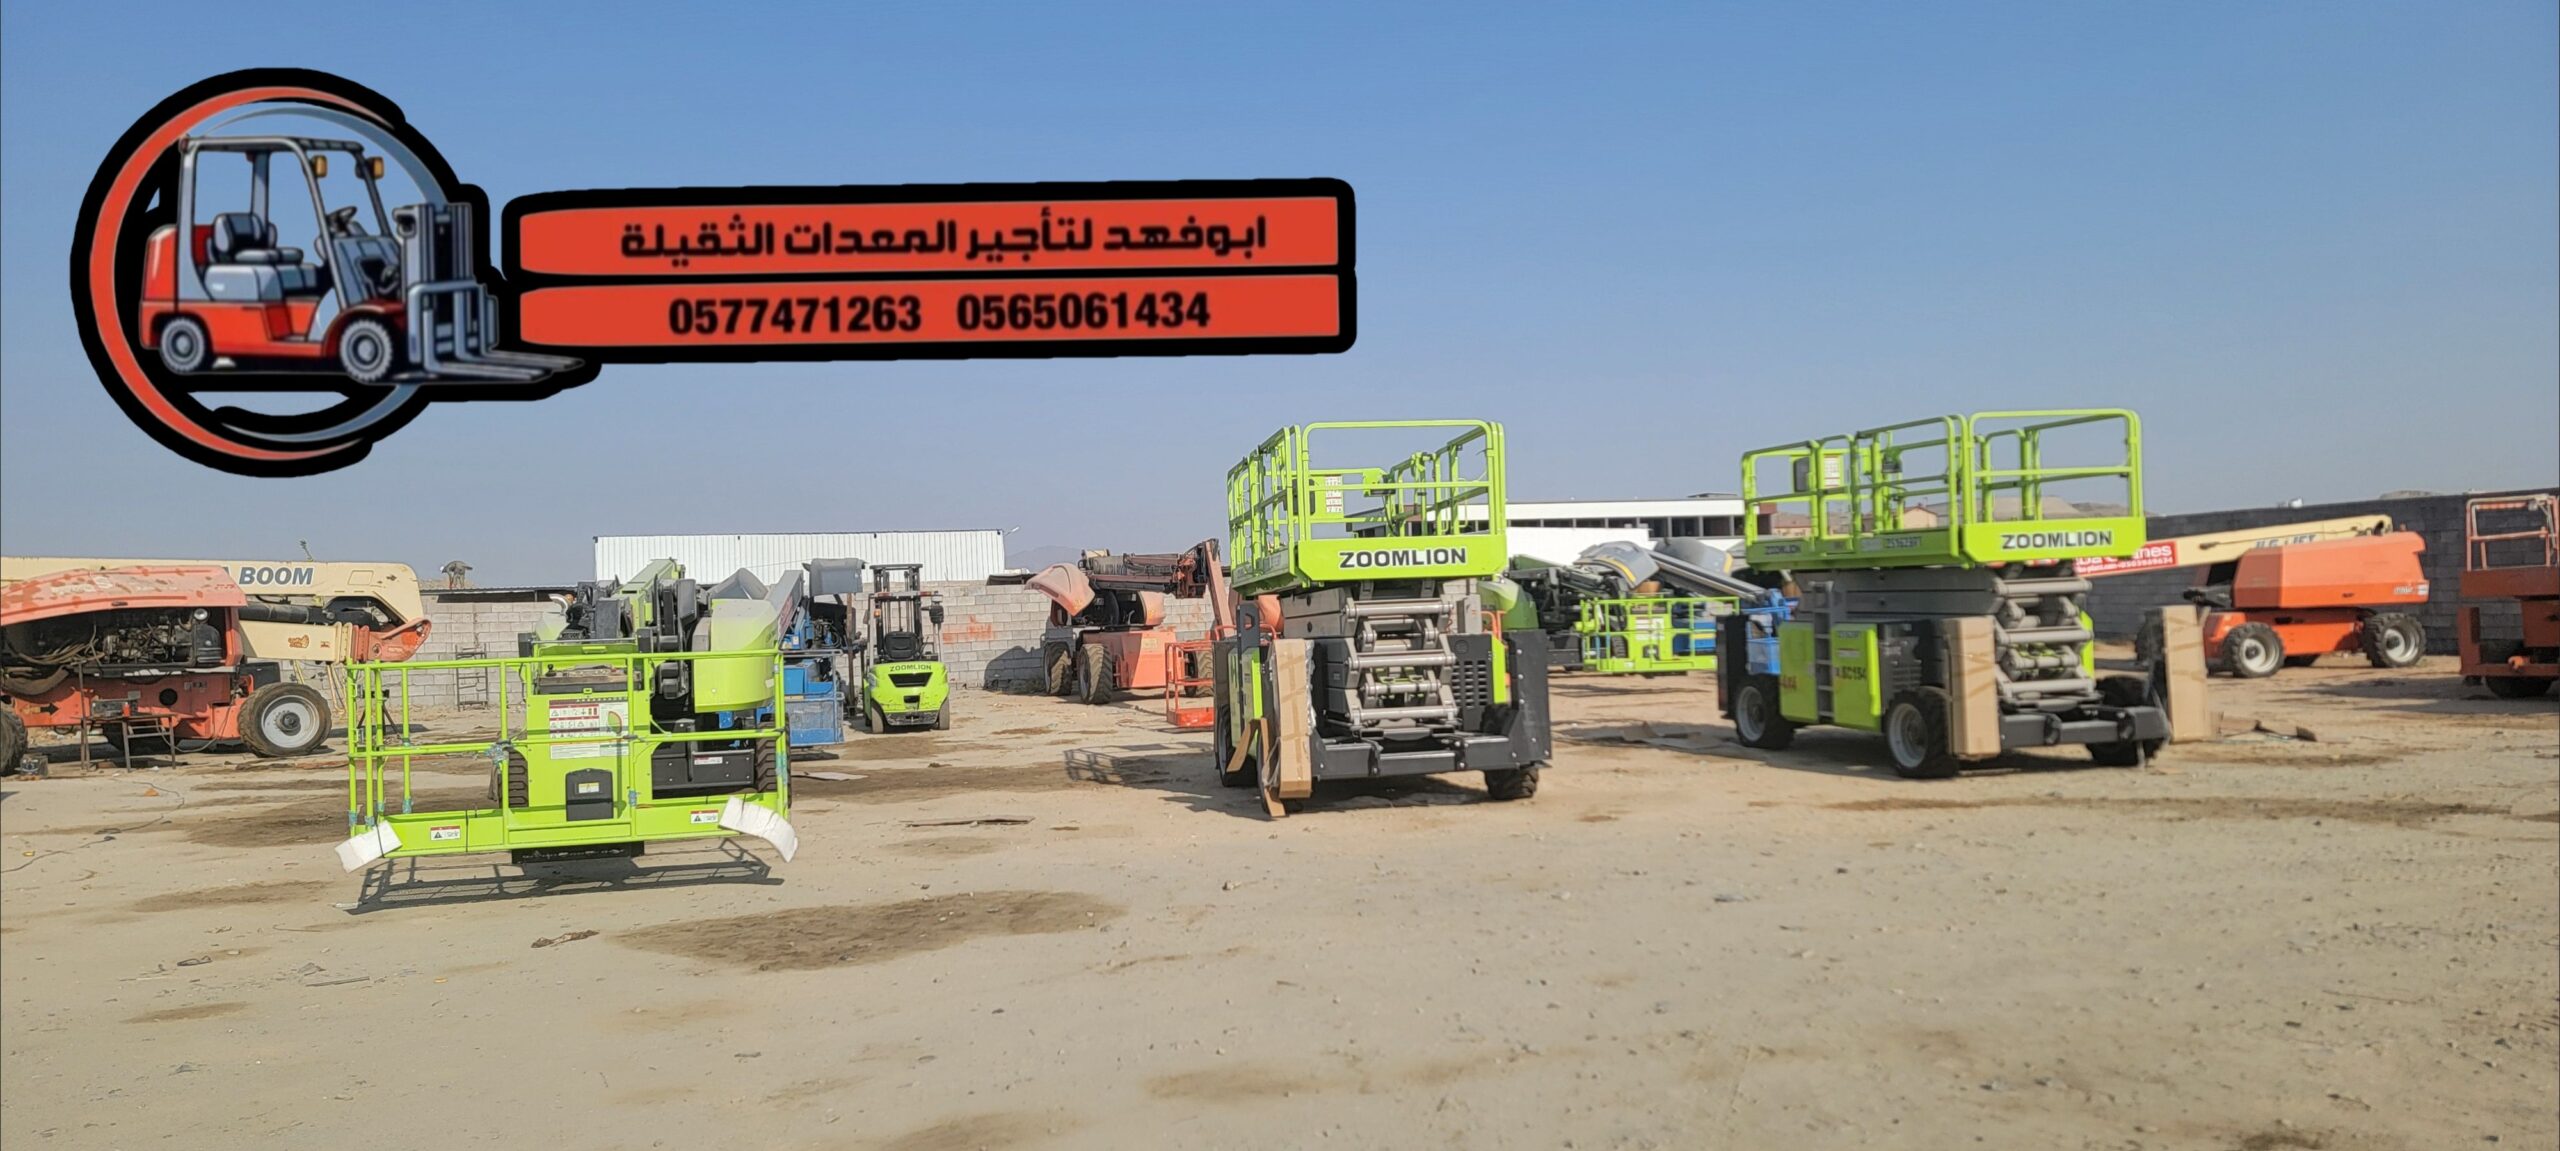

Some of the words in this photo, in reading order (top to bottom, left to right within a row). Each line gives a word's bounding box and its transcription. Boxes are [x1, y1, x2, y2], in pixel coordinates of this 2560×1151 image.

[2001, 531, 2113, 550] ZOOMLION
[1338, 548, 1467, 570] ZOOMLION
[238, 566, 314, 585] BOOM
